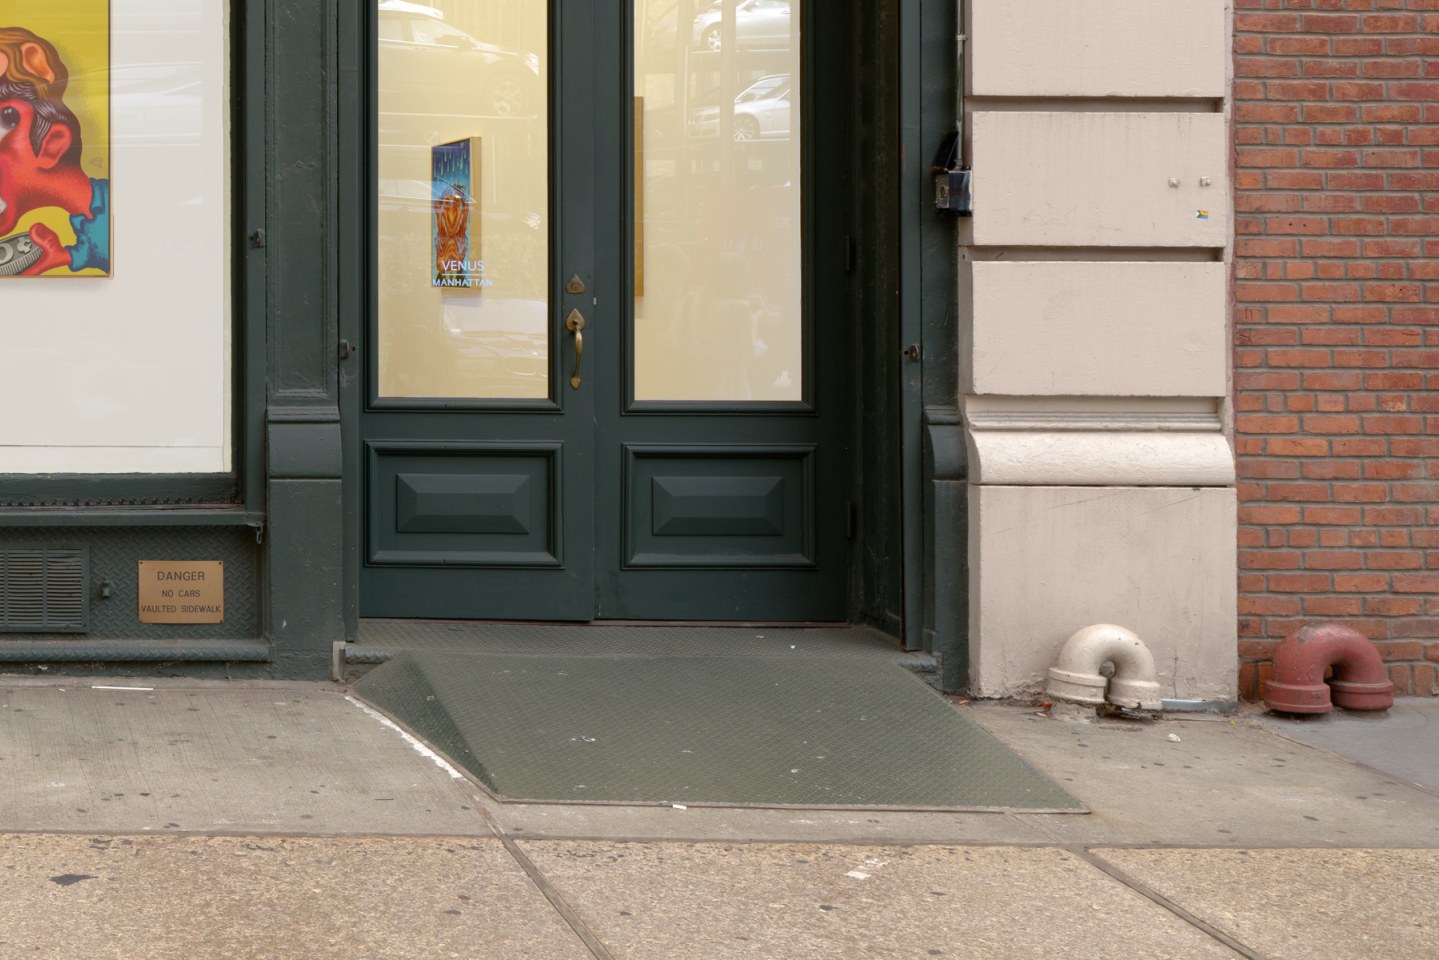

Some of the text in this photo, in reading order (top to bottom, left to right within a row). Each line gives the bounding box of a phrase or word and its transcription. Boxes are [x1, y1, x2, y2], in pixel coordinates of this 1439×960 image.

[441, 260, 485, 271] VENUS
[432, 278, 493, 287] MANHATTAN
[157, 571, 205, 581] DANGER
[161, 589, 201, 598] NO CARS
[141, 604, 222, 613] VAULTED SIDEWALK
